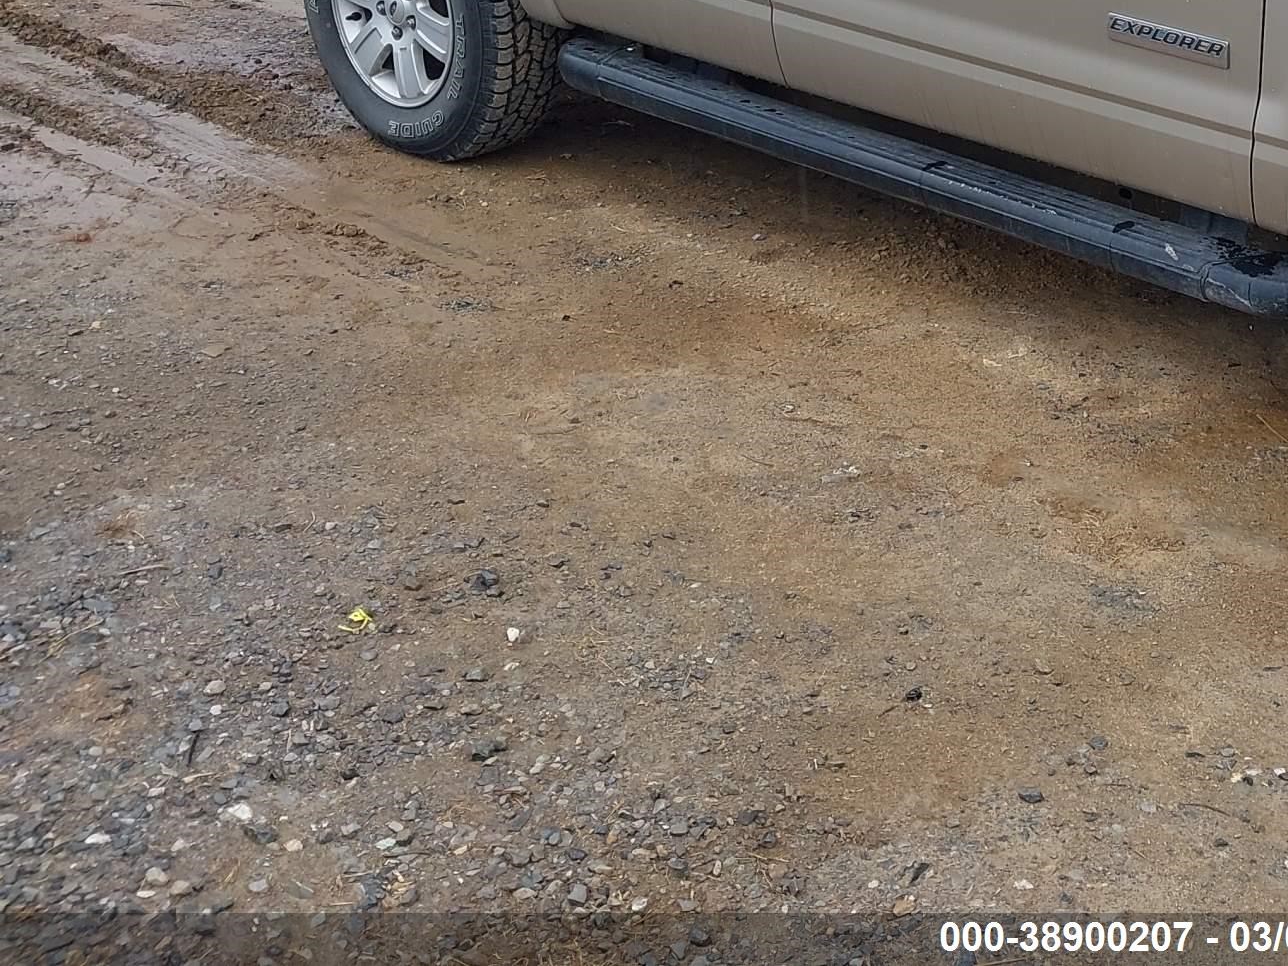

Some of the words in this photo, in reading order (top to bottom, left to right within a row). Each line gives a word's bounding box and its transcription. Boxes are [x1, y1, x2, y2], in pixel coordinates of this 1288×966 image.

[1109, 17, 1226, 56] EXPLORER
[447, 13, 466, 100] TRAIL
[388, 110, 444, 138] GUIDE
